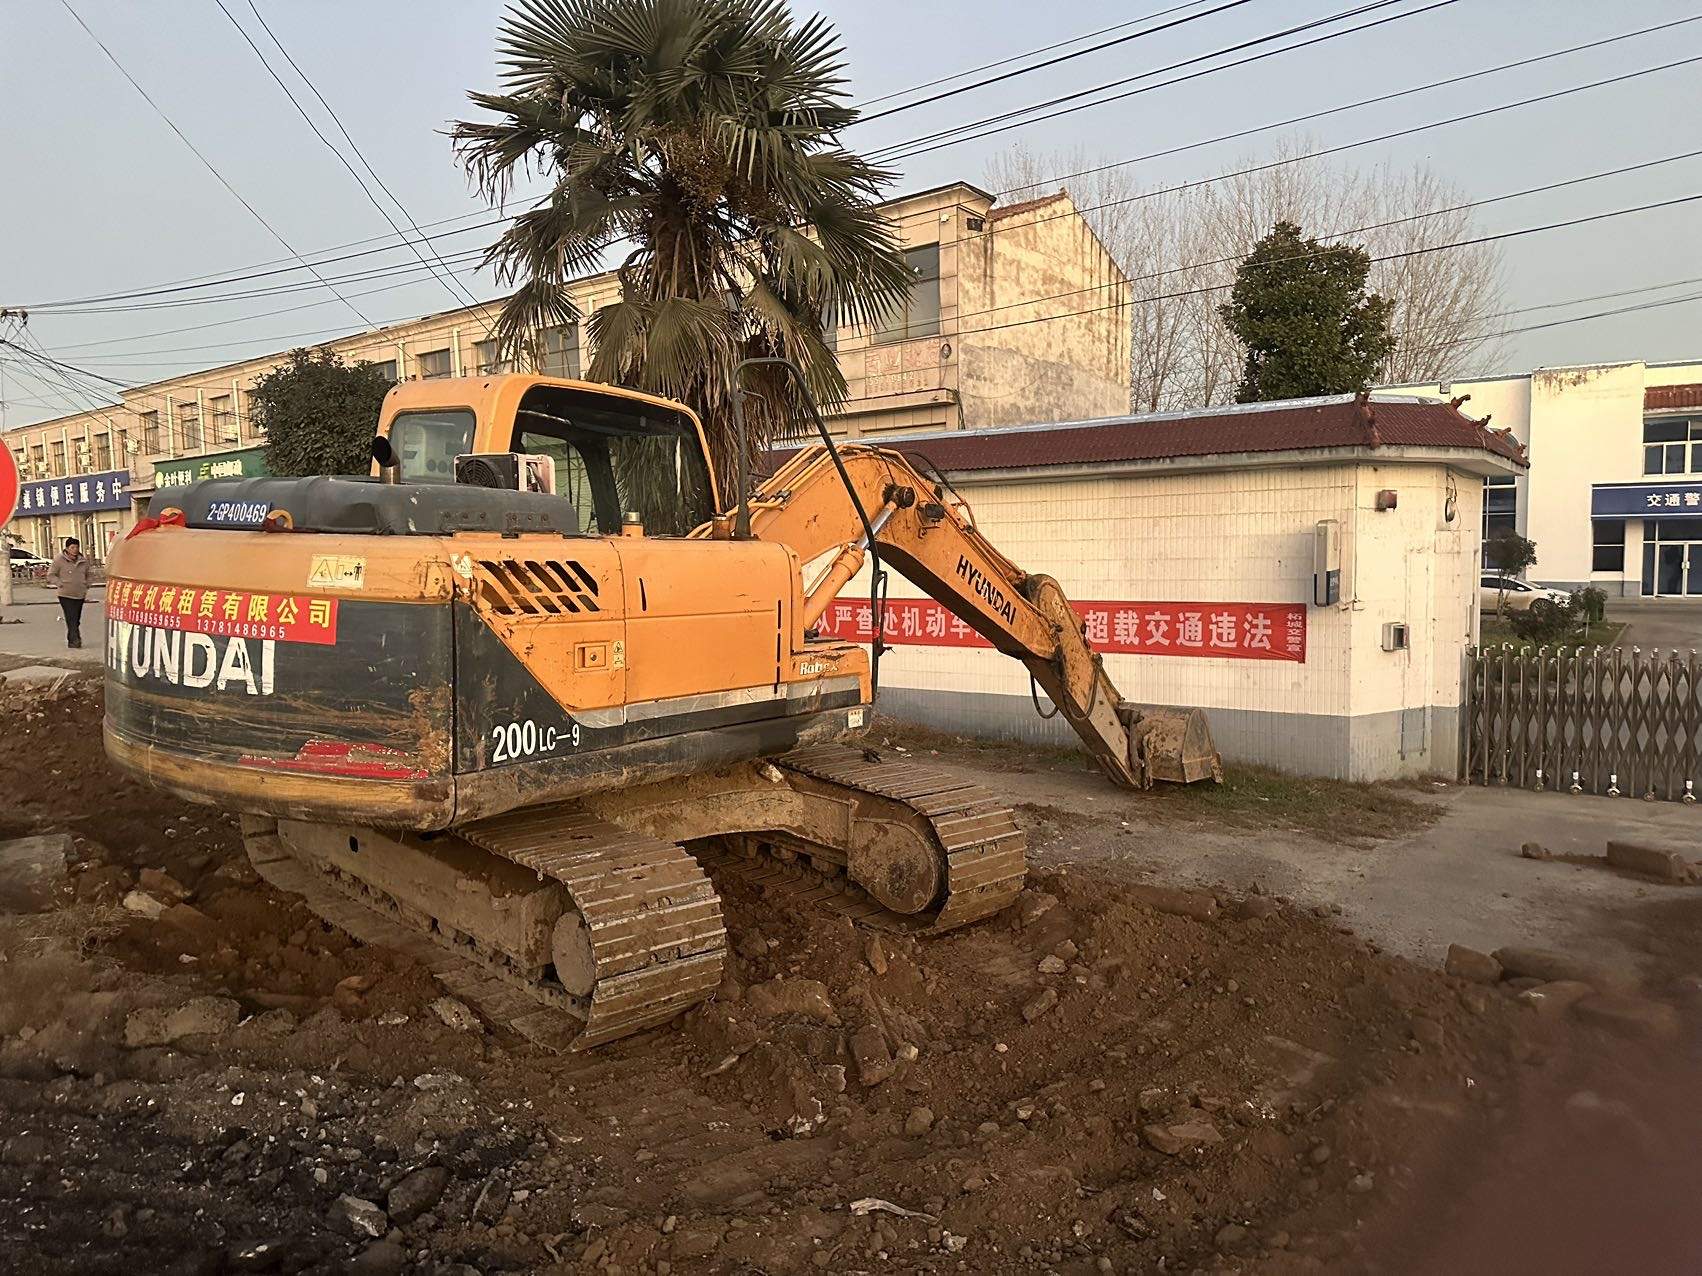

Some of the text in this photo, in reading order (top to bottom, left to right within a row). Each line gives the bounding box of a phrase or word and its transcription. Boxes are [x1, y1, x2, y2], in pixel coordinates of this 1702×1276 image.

[16, 478, 122, 510] 襄镇便民服务中
[1646, 492, 1700, 507] 交通警
[207, 503, 267, 523] 2-GP400469
[956, 554, 1016, 625] HYUNDAI
[197, 618, 285, 639] 13781486965
[813, 605, 986, 639] 从严查处机动车
[107, 618, 275, 696] HYUNDAI
